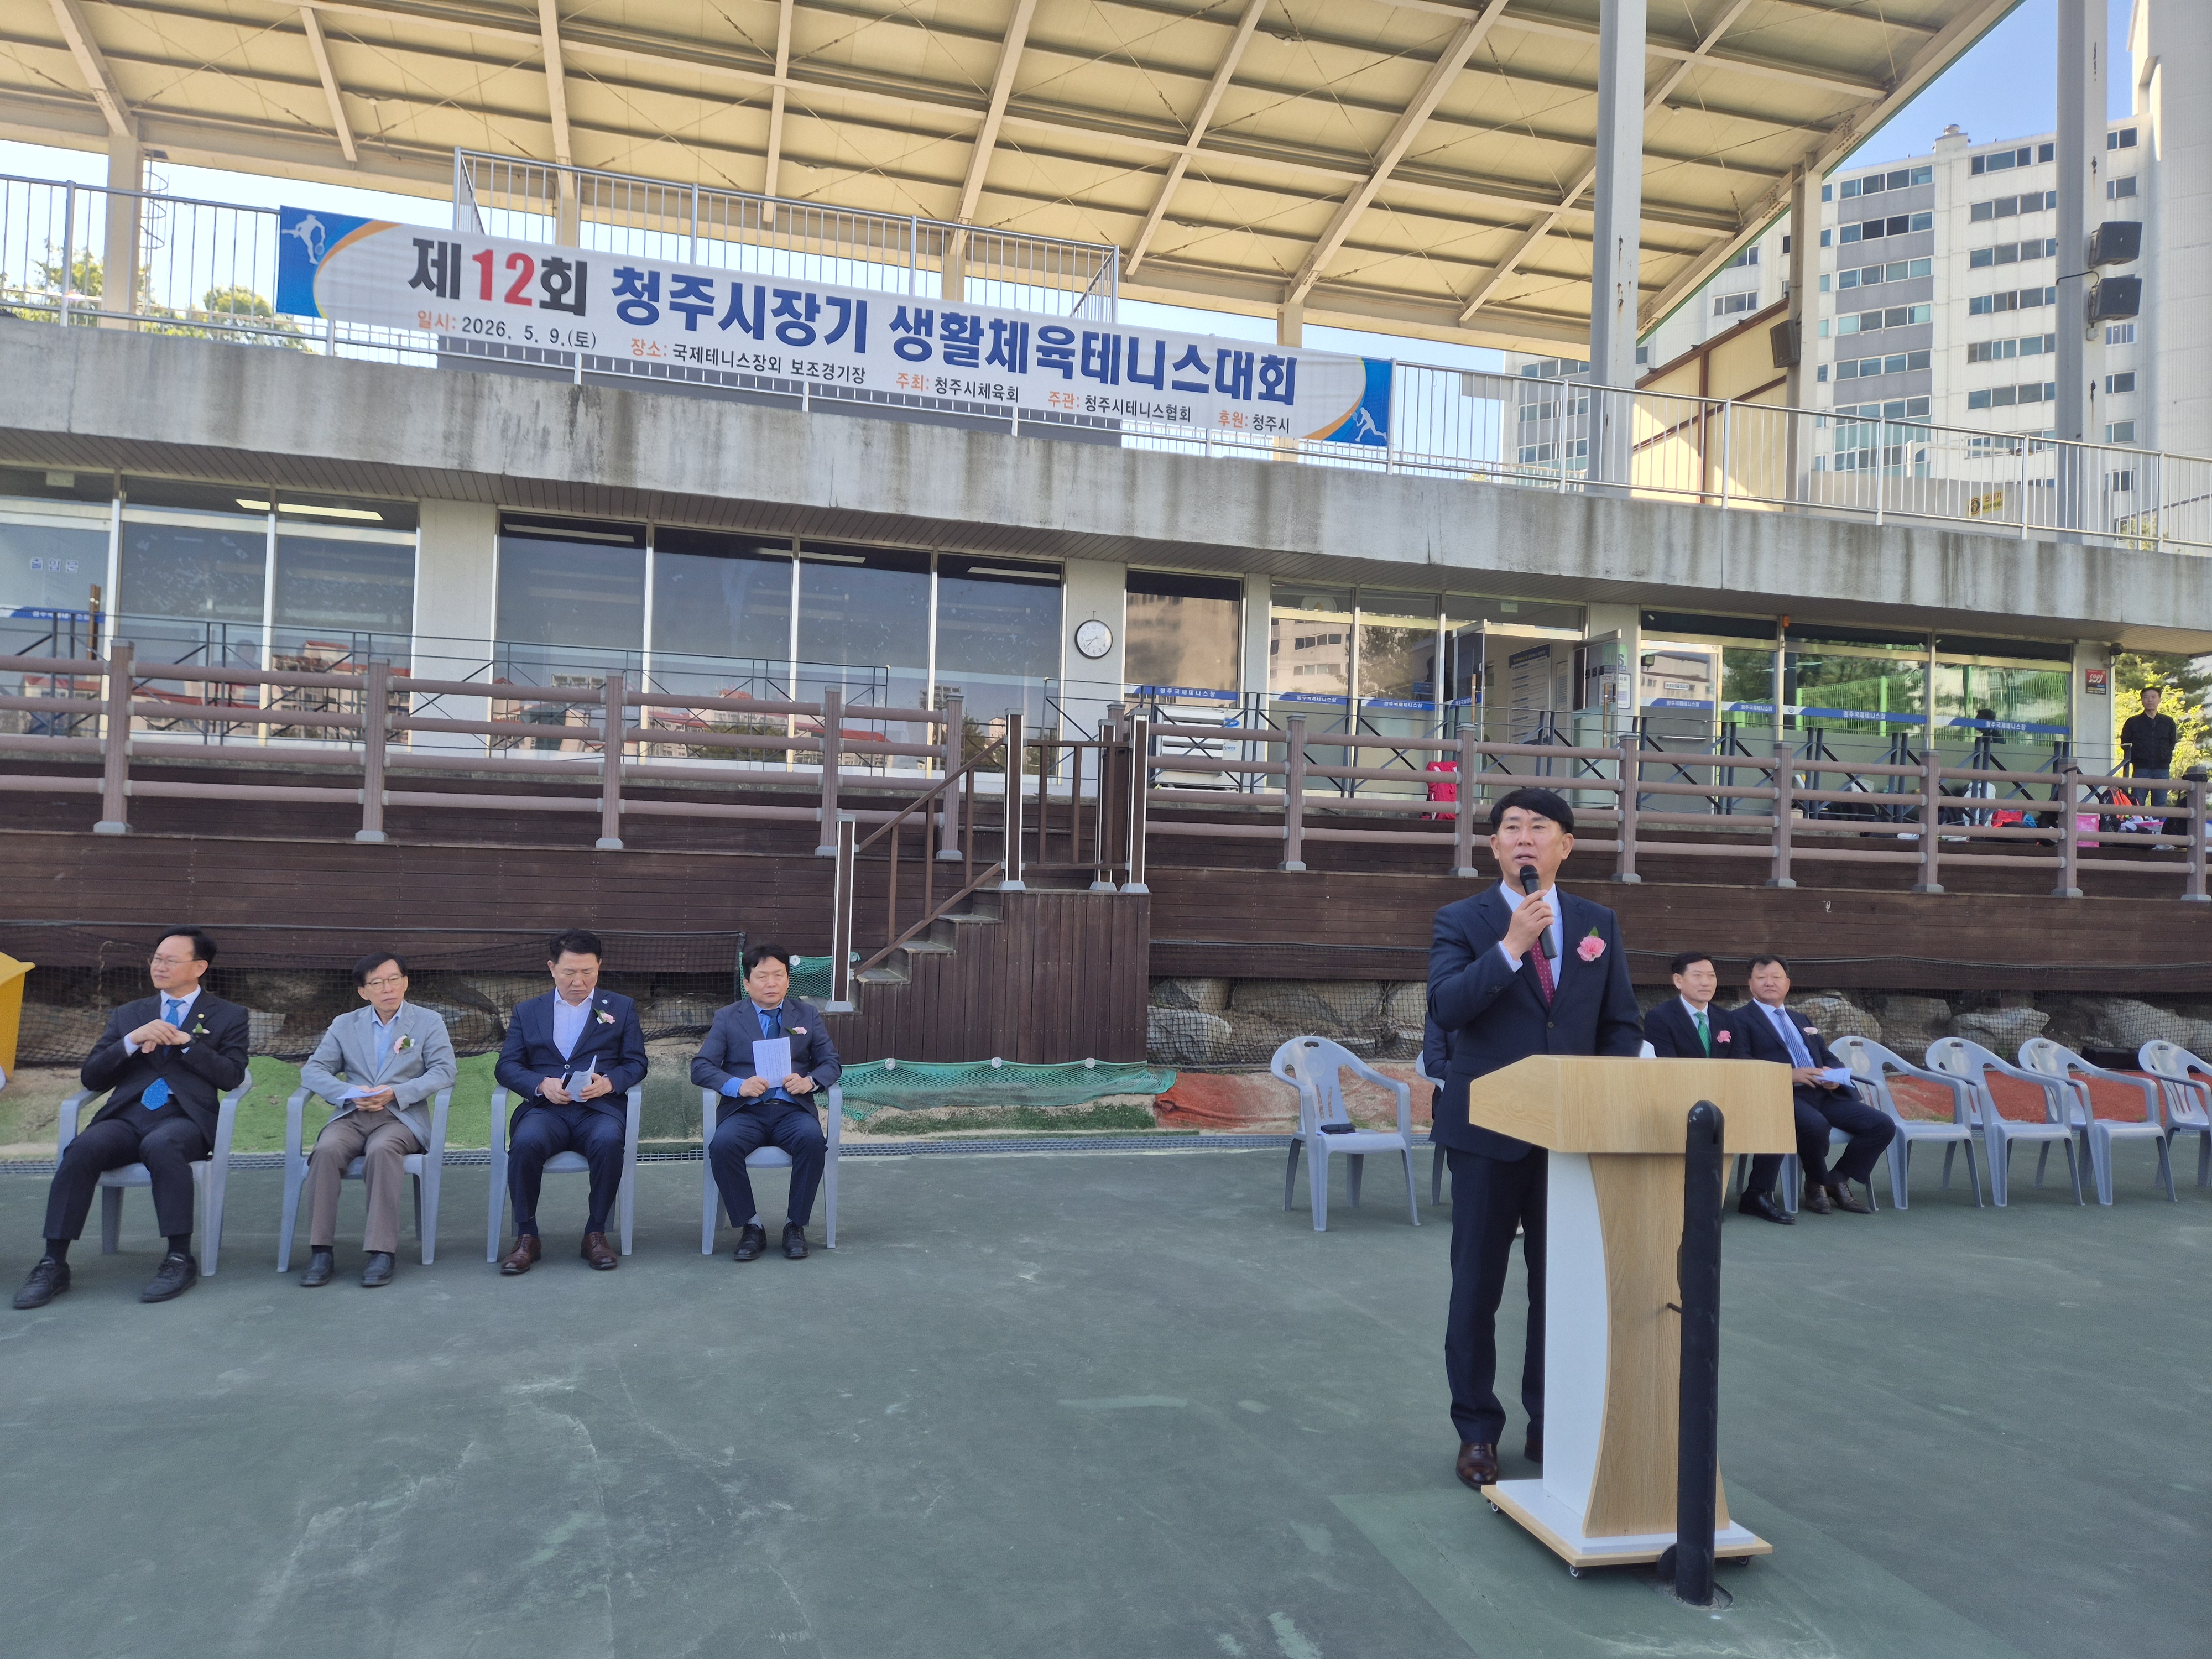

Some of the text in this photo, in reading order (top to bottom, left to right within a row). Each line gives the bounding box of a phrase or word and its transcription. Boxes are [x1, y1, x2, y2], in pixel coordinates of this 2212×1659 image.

[408, 237, 1298, 406] 제12회 청주시장기 생활체육테니스대회
[417, 310, 457, 331] 일시:
[461, 316, 512, 340] 2026.
[524, 323, 539, 343] 5.
[630, 338, 668, 358] 장소:
[672, 343, 781, 374] 국제테니스장외
[790, 358, 866, 384] 보조경기장
[896, 372, 930, 392] 주최:
[934, 376, 1019, 403] 청주시체육회
[1048, 390, 1081, 409] 주관:
[1084, 394, 1192, 423] 청주시테니스협회
[1218, 410, 1249, 429] 후원:
[1253, 414, 1290, 434] 청주시
[31, 557, 79, 573] 출입문
[1160, 687, 1216, 697] 청주국제테니스장
[1843, 711, 1886, 720] 청주국제테니스장
[1986, 721, 2026, 731] 청주국제테니스장
